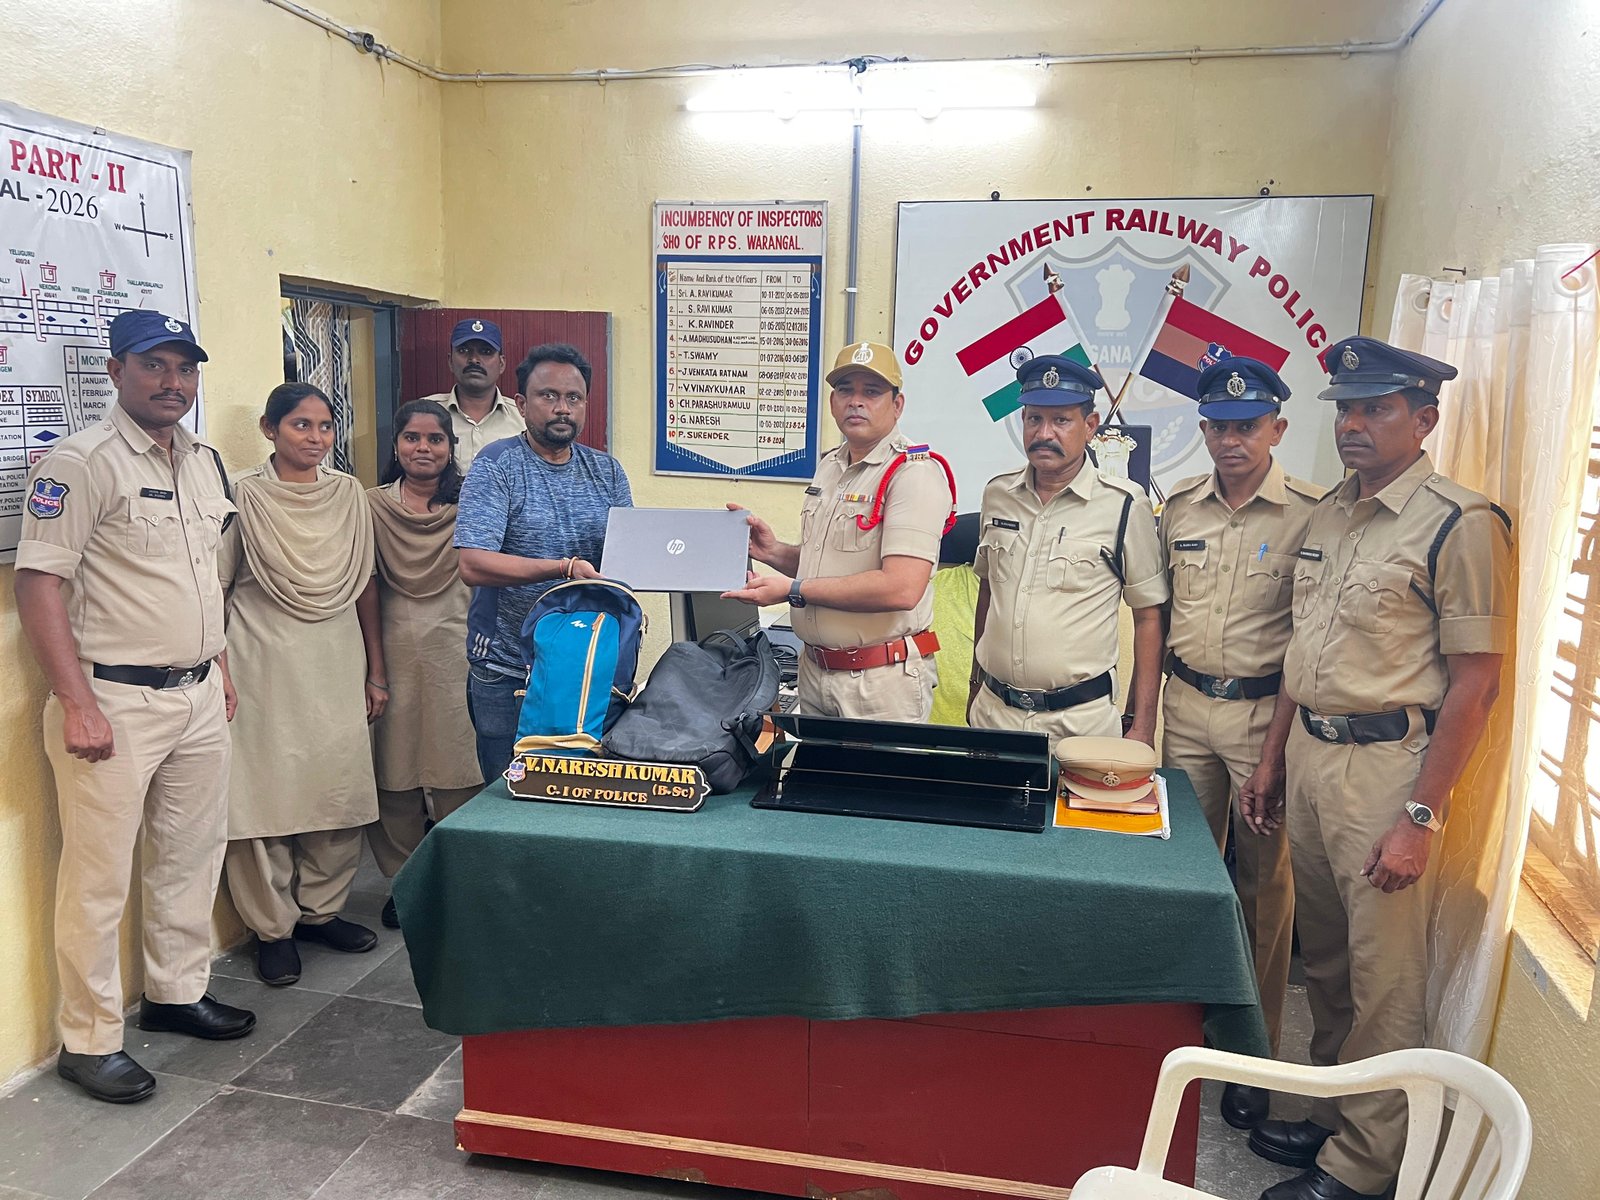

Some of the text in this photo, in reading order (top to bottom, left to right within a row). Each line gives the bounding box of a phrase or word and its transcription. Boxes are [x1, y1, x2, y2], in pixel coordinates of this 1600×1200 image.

[9, 139, 82, 184] PART
[660, 210, 823, 228] INCUMBENCY OF INSPECTORS
[114, 223, 122, 231] W
[685, 235, 703, 249] OF
[679, 273, 694, 282] Name
[717, 274, 724, 283] of
[725, 274, 735, 283] the
[766, 275, 782, 284] FROM
[792, 275, 802, 284] TO
[904, 208, 1335, 374] GOVERNMENT RAILWAY POLIC
[81, 377, 109, 385] JANUARY
[0, 390, 61, 403] EX SYMBOL
[82, 389, 114, 397] FEBRUARY
[83, 401, 107, 409] MARCH
[668, 399, 675, 408] 8
[668, 414, 675, 424] 9
[668, 539, 684, 555] hp
[624, 765, 697, 785] KUMAR
[572, 787, 592, 799] OF
[594, 789, 648, 803] POLICE
